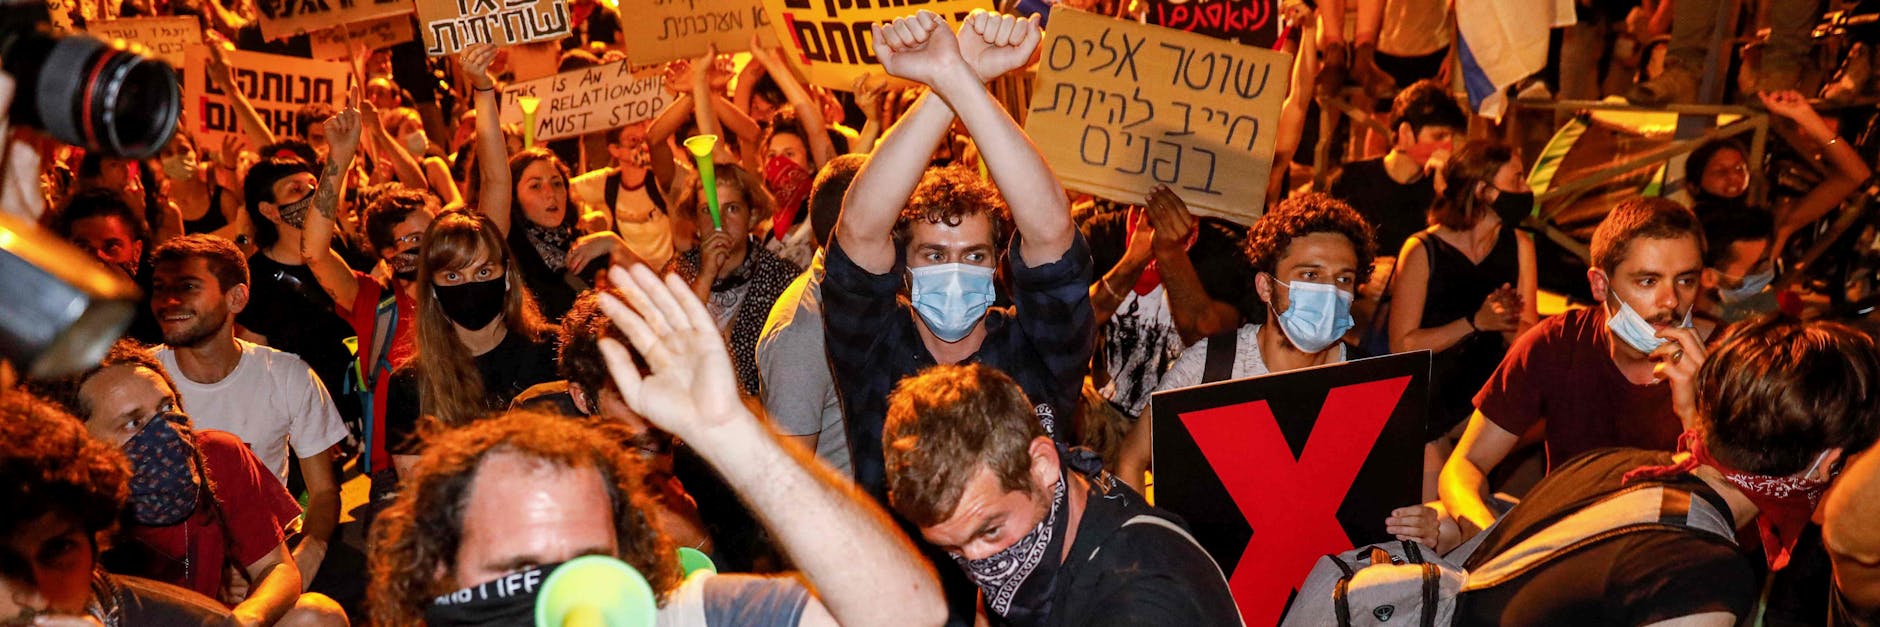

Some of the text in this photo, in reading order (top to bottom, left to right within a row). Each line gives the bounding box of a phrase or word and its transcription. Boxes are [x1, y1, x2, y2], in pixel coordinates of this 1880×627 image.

[551, 78, 567, 92] IS
[579, 69, 602, 88] AN
[1048, 27, 1271, 100] שוטר אלים
[537, 97, 664, 138] MUST STOP
[550, 75, 667, 114] RELATIONSHIP
[1032, 82, 1259, 151] חייב להיות
[1079, 124, 1223, 196] בפנים
